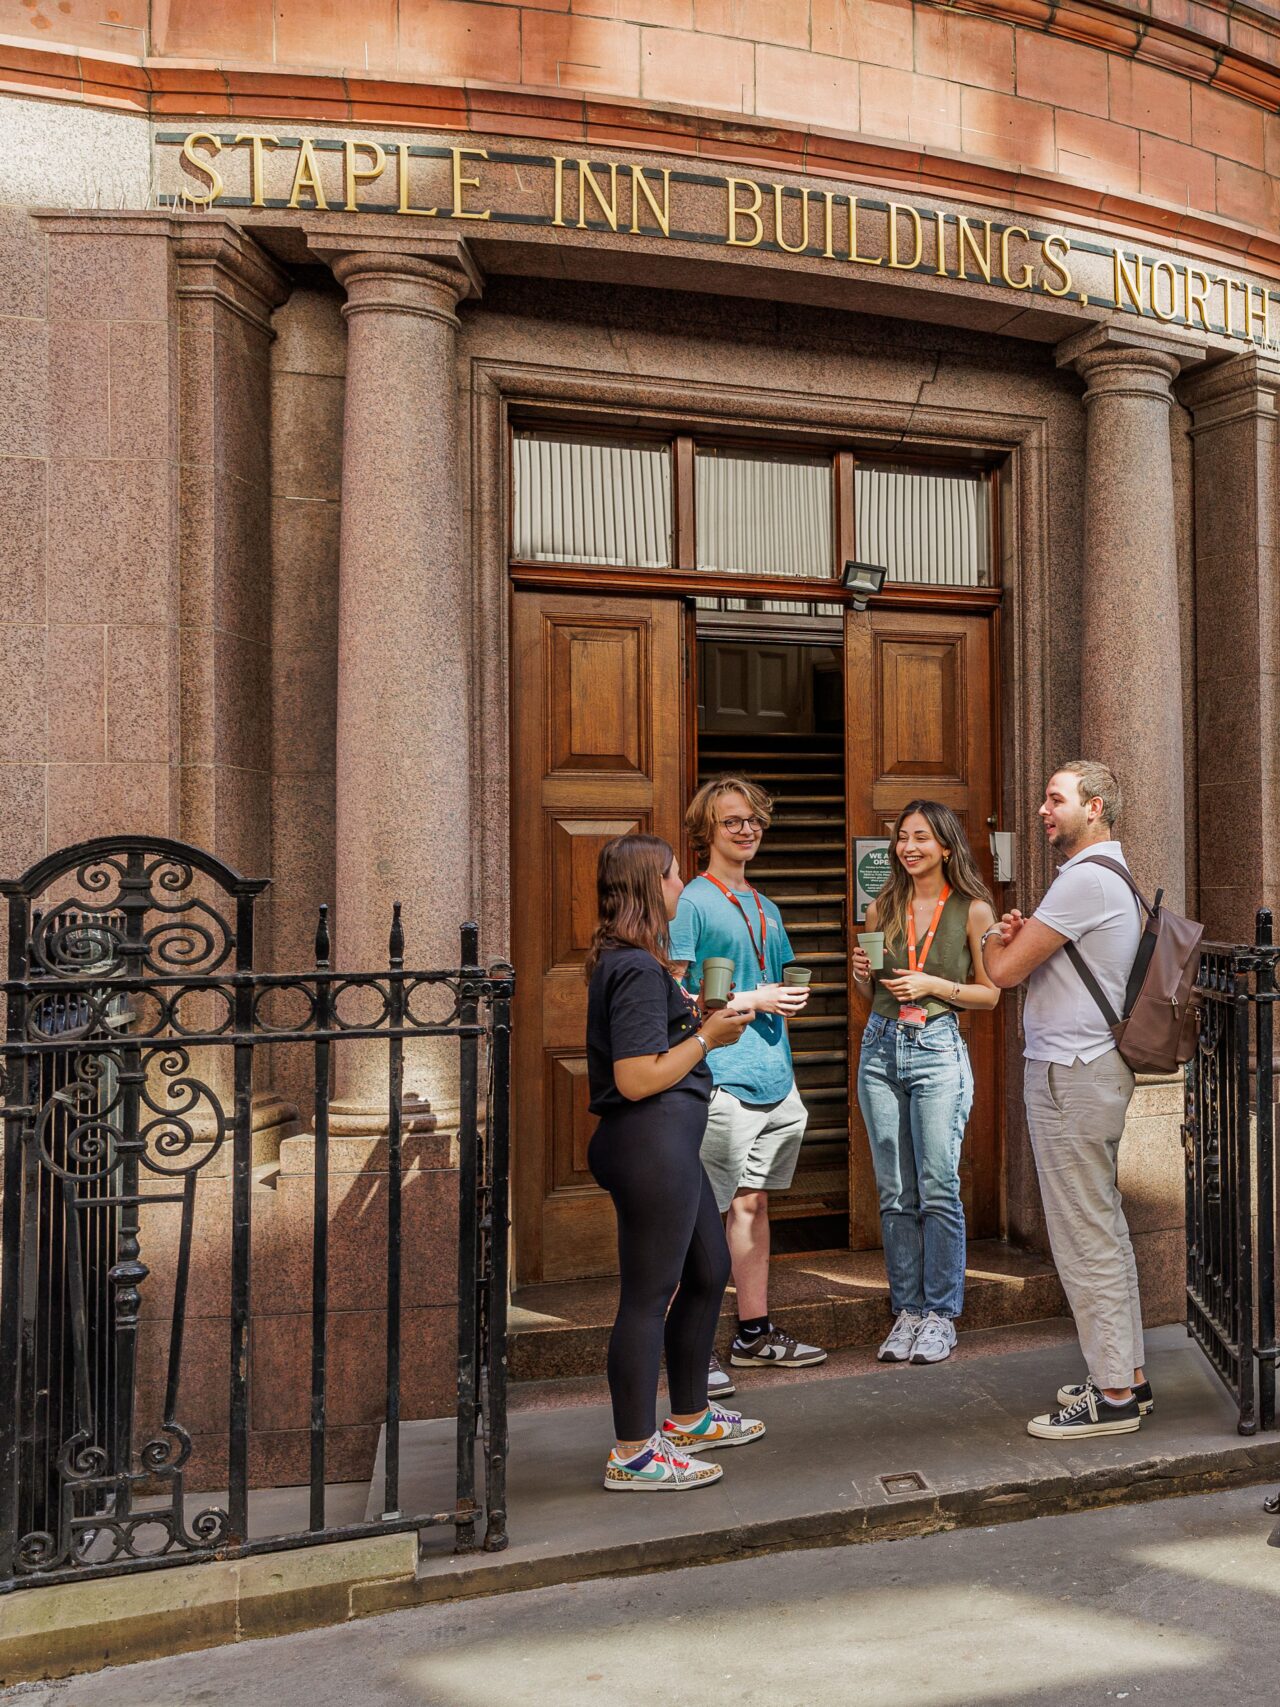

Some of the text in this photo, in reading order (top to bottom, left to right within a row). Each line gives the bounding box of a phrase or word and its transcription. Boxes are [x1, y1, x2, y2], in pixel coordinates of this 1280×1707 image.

[181, 131, 1273, 346] STAPLE INN BUILDINGS, NORTH
